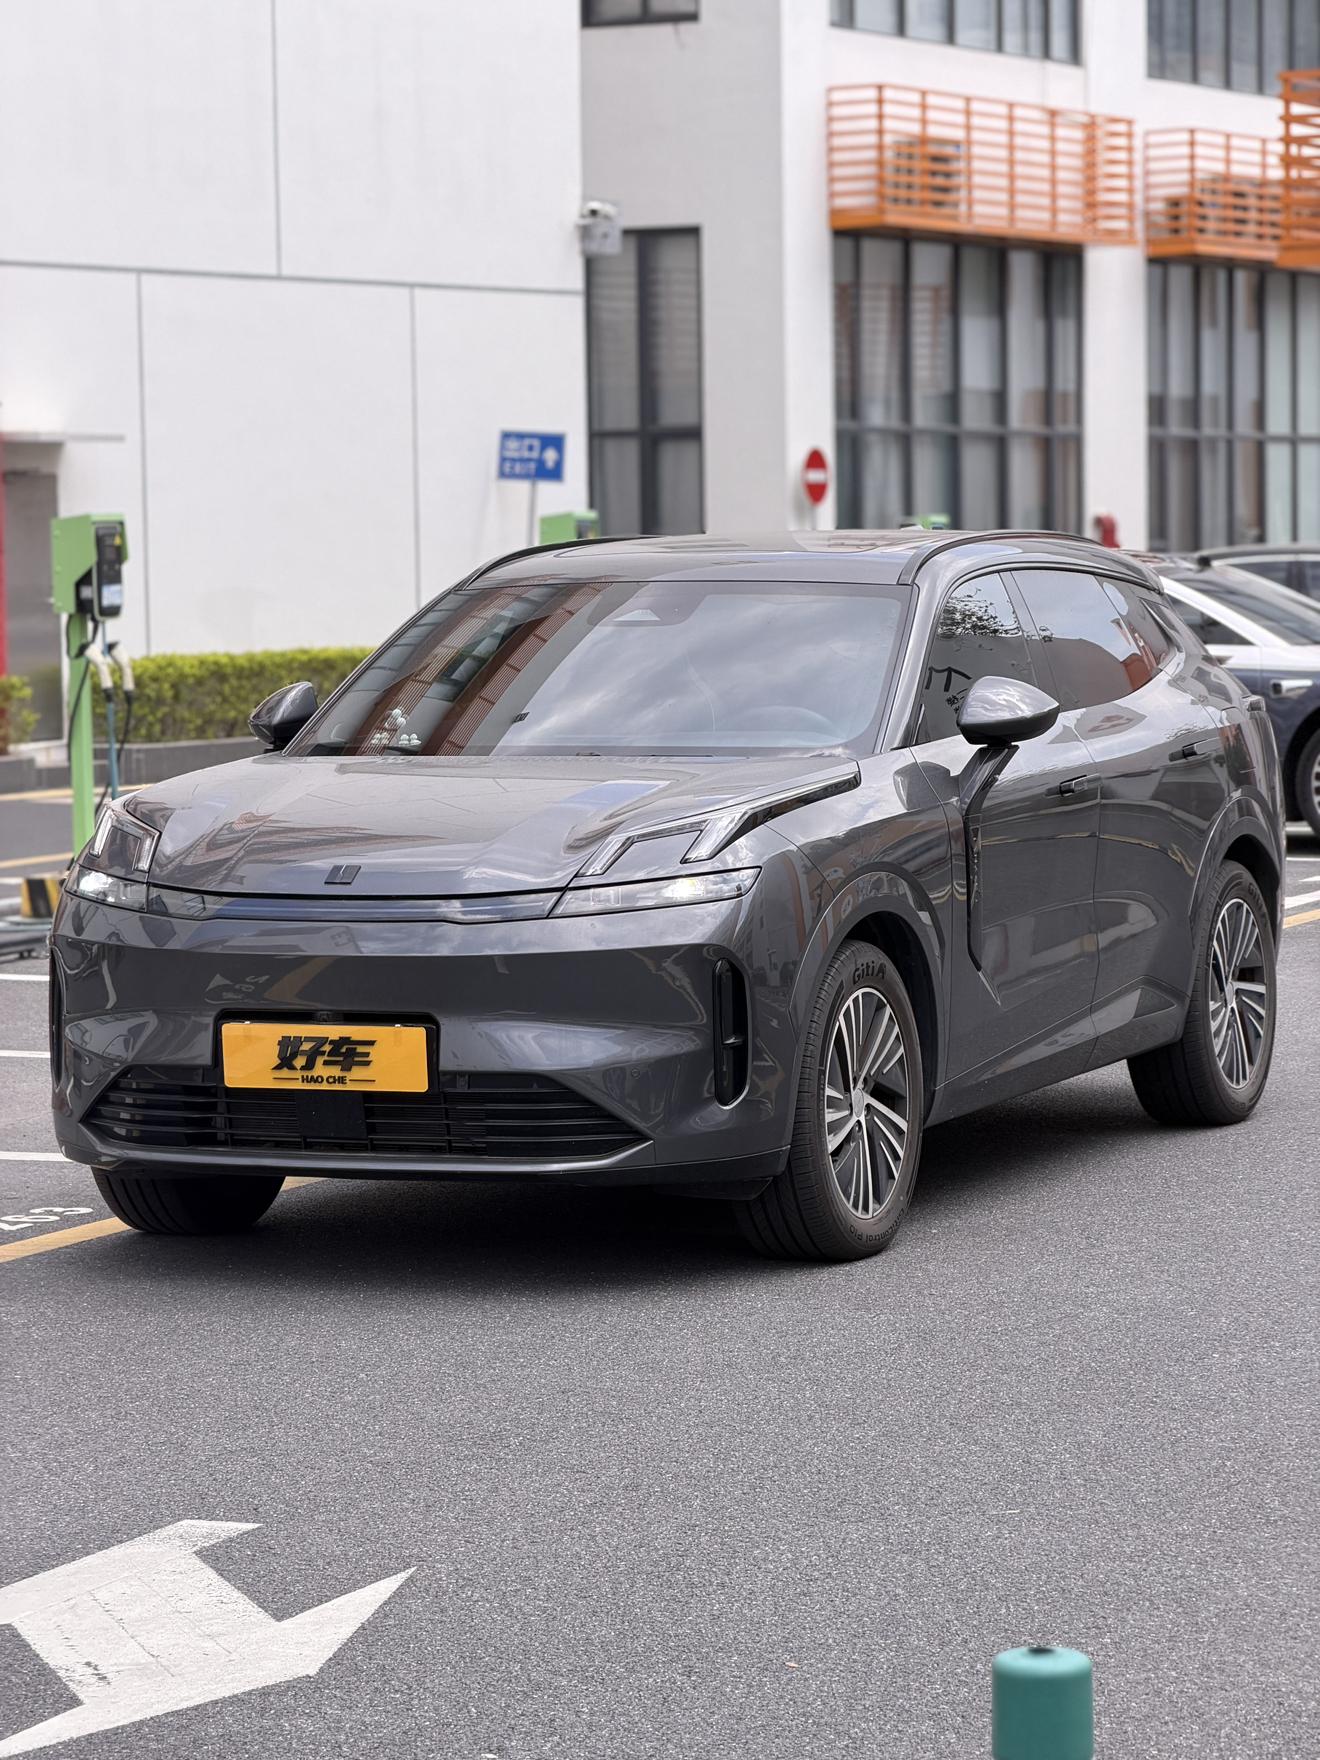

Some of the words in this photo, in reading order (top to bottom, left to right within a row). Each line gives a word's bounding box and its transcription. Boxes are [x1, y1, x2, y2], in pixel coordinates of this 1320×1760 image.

[271, 1035, 377, 1072] 好车
[301, 1074, 324, 1084] HAO
[325, 1075, 347, 1085] CHE
